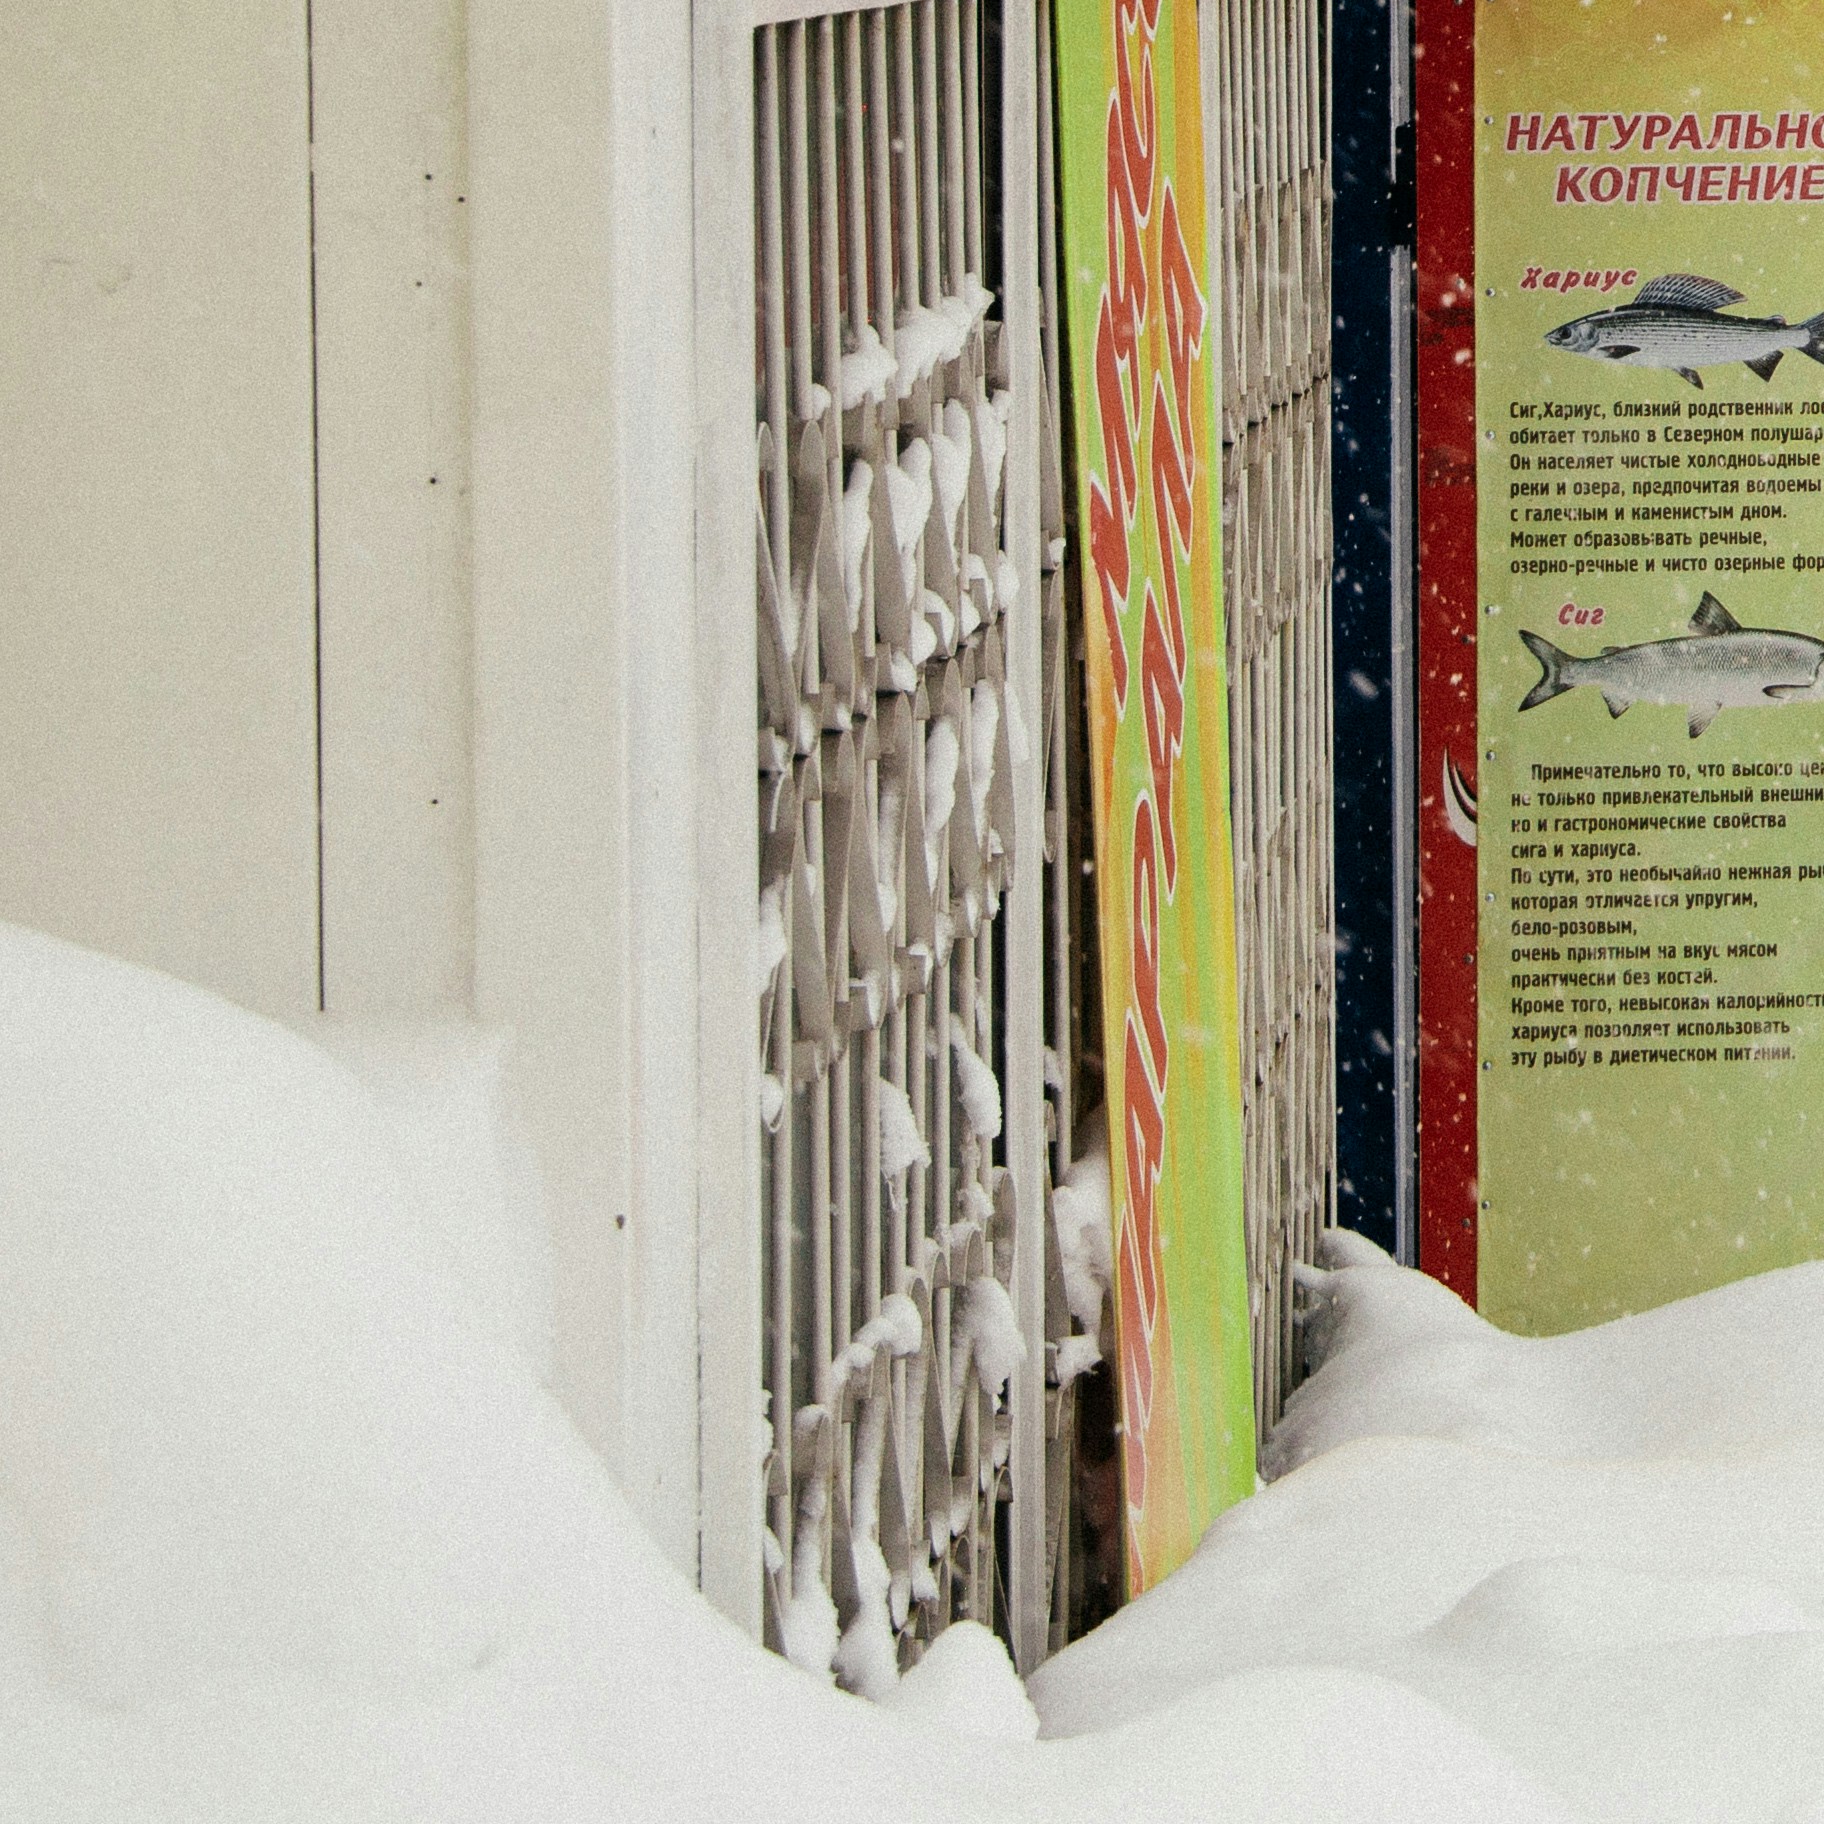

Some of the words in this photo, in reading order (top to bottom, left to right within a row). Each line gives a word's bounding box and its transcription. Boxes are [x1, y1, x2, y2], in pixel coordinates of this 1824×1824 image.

[1519, 266, 1640, 294] Хариус
[1509, 400, 1607, 421] Сиг,Хариус,
[1612, 400, 1682, 418] близкий
[1687, 401, 1794, 420] родственник
[1508, 427, 1576, 445] обитает
[1581, 429, 1641, 444] только
[1646, 429, 1657, 444] в
[1663, 425, 1744, 444] Северном
[1509, 453, 1531, 472] Он
[1537, 455, 1614, 471] населяет
[1620, 454, 1681, 469] чистые
[1687, 452, 1821, 470] холодноводные
[1509, 481, 1550, 499] реки
[1556, 481, 1567, 496] и
[1573, 481, 1626, 499] озера,
[1632, 479, 1740, 498] предпочитая
[1746, 478, 1822, 495] водоемы
[1509, 507, 1519, 523] с
[1524, 507, 1608, 523] галечным
[1614, 506, 1625, 521] и
[1631, 505, 1734, 521] каменистым
[1739, 504, 1788, 522] дном.
[1509, 530, 1567, 549] Может
[1573, 529, 1693, 549] образовывать
[1698, 530, 1768, 549] речные,
[1509, 558, 1639, 576] озерно-речные
[1644, 558, 1656, 573] и
[1661, 557, 1708, 572] чисто
[1713, 556, 1786, 575] озерные
[1556, 602, 1606, 628] Сиг
[1530, 763, 1662, 784] Примечательно
[1667, 763, 1691, 781] то,
[1696, 763, 1726, 778] что
[1731, 762, 1793, 778] высоко
[1510, 793, 1531, 808] не
[1536, 791, 1596, 807] только
[1602, 787, 1754, 807] привлекательный
[1510, 818, 1531, 834] но
[1537, 818, 1548, 833] и
[1553, 815, 1707, 834] гастрономические
[1712, 813, 1787, 830] свойства
[1510, 843, 1548, 860] сига
[1553, 843, 1564, 858] и
[1570, 842, 1642, 860] хариуса.
[1117, 173, 1210, 1581] МАРАЛА
[1510, 867, 1532, 885] По
[1538, 869, 1580, 886] сути,
[1586, 868, 1613, 884] это
[1619, 866, 1722, 883] необычайно
[1727, 865, 1792, 881] нежная
[1510, 895, 1578, 913] которая
[1585, 893, 1680, 910] отличается
[1684, 892, 1759, 911] упругим,
[1510, 919, 1638, 938] бело-розовым,
[1510, 947, 1561, 963] очень
[1567, 945, 1651, 963] приятным
[1657, 944, 1677, 960] на
[1682, 944, 1721, 962] вкус
[1726, 943, 1778, 959] мясом
[1510, 972, 1616, 990] практически
[1622, 970, 1651, 986] без
[1656, 969, 1718, 986] костей.
[1510, 996, 1565, 1017] Кроме
[1570, 998, 1612, 1015] того,
[1618, 996, 1710, 1012] невысокая
[1511, 1024, 1578, 1043] хариуса
[1583, 1022, 1671, 1039] позволяет
[1676, 1021, 1791, 1037] использовать
[1511, 1051, 1538, 1069] эту
[1543, 1048, 1587, 1068] рыбу
[1592, 1049, 1604, 1065] в
[1608, 1048, 1718, 1067] диетическом
[1723, 1047, 1796, 1062] питании.
